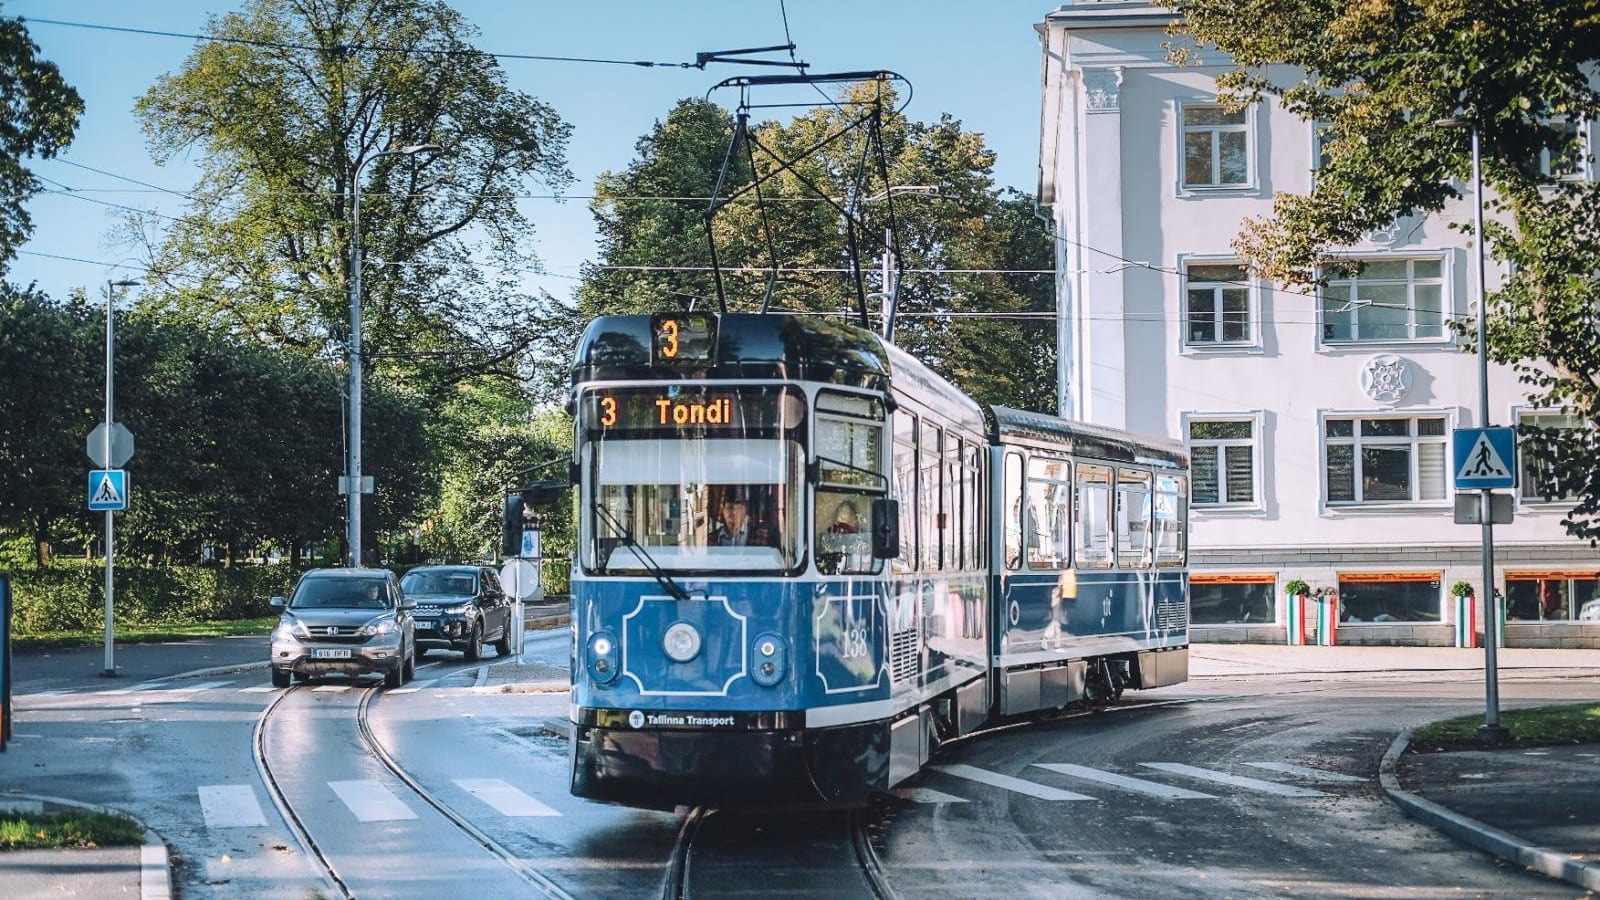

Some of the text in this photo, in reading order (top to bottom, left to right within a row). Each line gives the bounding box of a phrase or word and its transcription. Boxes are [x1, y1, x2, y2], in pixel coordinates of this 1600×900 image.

[662, 319, 680, 358] 3
[601, 397, 731, 426] 3 Tondi
[842, 628, 867, 658] 138
[647, 715, 735, 727] Tallinna Transport
